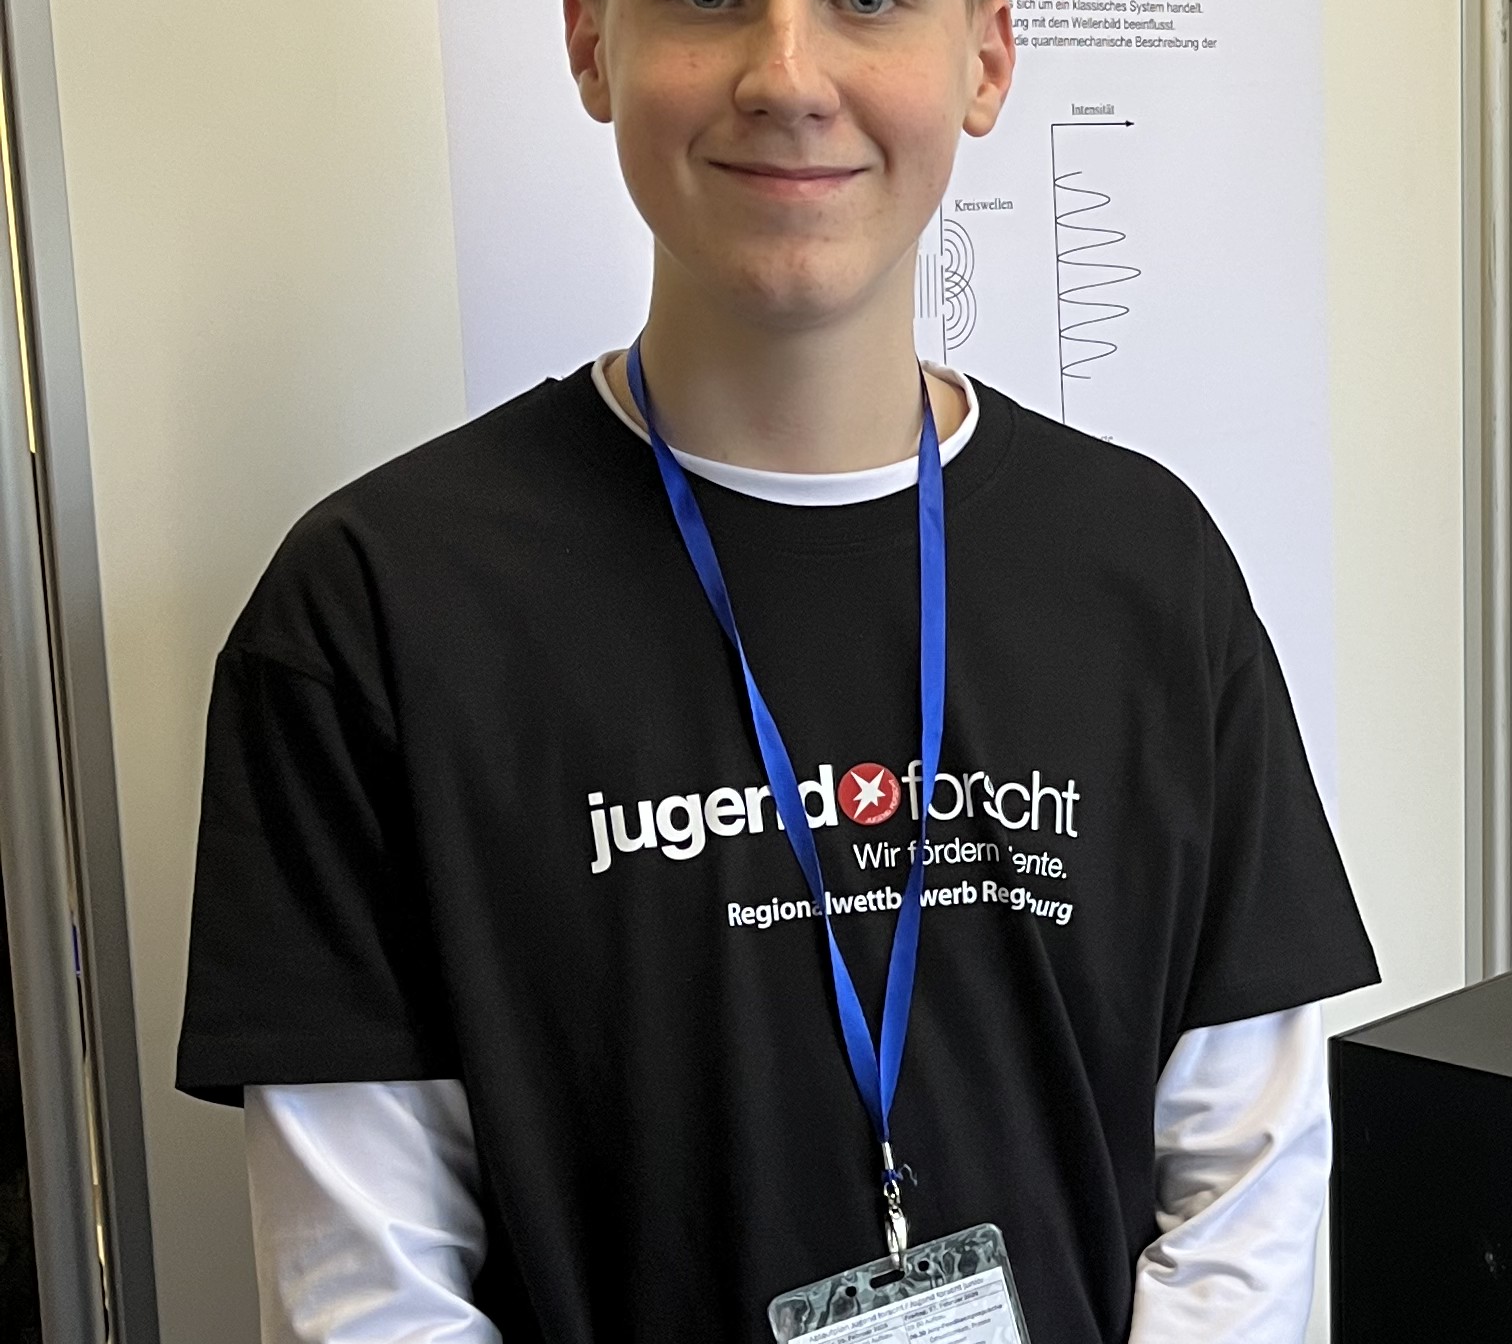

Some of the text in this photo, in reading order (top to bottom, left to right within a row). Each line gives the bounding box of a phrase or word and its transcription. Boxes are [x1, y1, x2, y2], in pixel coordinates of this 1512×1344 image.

[1037, 0, 1054, 11] um
[1055, 0, 1070, 11] ein
[1129, 0, 1165, 16] System
[1166, 1, 1204, 14] handelt.
[1031, 15, 1176, 31] mit dem Wellenbild beeinflusst.
[1014, 35, 1218, 52] die quantenmechanische Beschreibung der
[1071, 103, 1115, 115] Intensität
[954, 199, 1014, 212] Kreiswellen
[852, 841, 902, 870] Wir
[727, 879, 978, 930] Regionalwettbwerb
